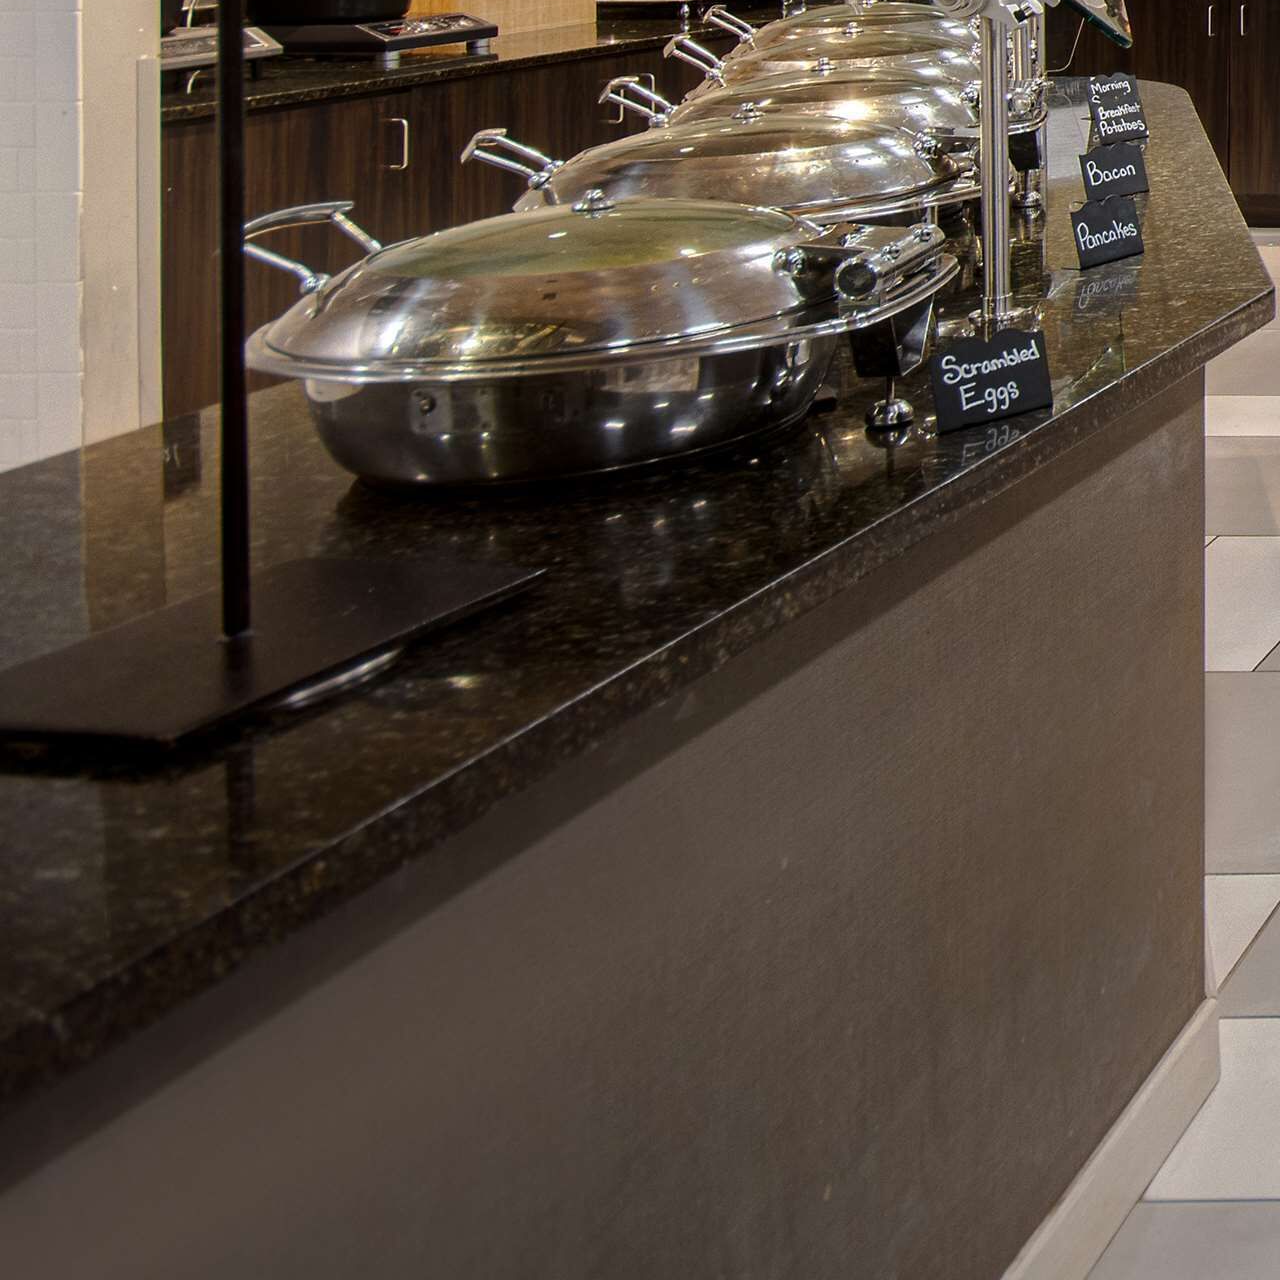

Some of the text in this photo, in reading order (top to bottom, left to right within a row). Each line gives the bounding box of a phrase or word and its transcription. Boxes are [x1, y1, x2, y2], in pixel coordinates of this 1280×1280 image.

[1090, 80, 1131, 95] Morning
[1098, 102, 1141, 120] Breakfast
[1100, 118, 1146, 137] Potatoes
[1086, 160, 1136, 186] Bacon
[1076, 220, 1138, 251] Pancakes
[941, 339, 1040, 385] Scrambled
[959, 381, 1020, 413] Eggs
